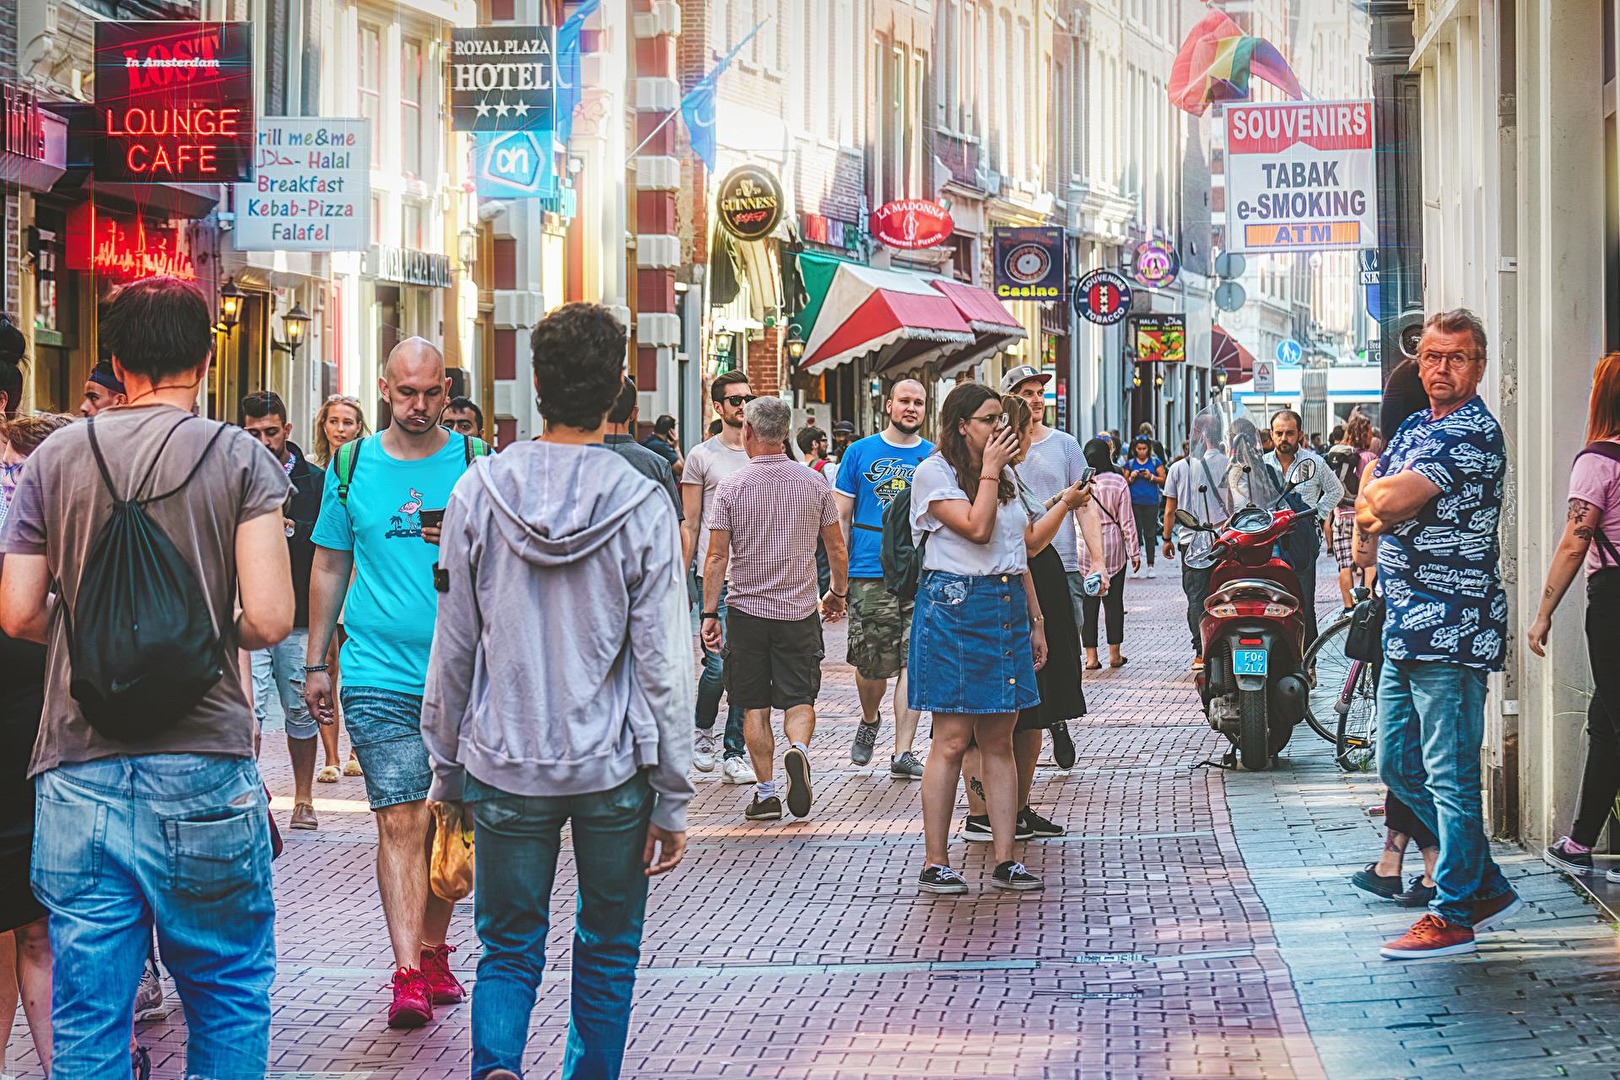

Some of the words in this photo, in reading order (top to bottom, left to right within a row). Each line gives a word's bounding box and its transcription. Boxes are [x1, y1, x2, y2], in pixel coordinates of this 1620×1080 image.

[455, 40, 502, 56] ROYAL
[504, 39, 550, 55] PLAZA
[123, 35, 220, 90] LOST
[125, 57, 140, 68] In
[143, 56, 220, 68] Amsterdam
[454, 63, 550, 91] HOTEL
[105, 108, 239, 136] LOUNGE
[1232, 105, 1367, 140] SOUVENIRS
[258, 128, 282, 146] rill
[288, 128, 355, 146] me&me
[127, 144, 217, 174] CAFE
[308, 151, 350, 168] Halal
[257, 175, 345, 193] Breakfast
[1262, 161, 1340, 189] TABAK
[248, 199, 353, 217] Kebab-Pizza
[721, 196, 777, 212] GUINNESS
[876, 207, 891, 220] LA
[892, 202, 945, 220] MADONNA
[1237, 190, 1366, 220] e-SMOKING
[272, 223, 330, 241] Falafel
[1274, 224, 1332, 244] ATM
[998, 284, 1059, 297] Casino
[1082, 274, 1126, 292] SOUVENIRS
[1086, 307, 1125, 323] TOBACCO
